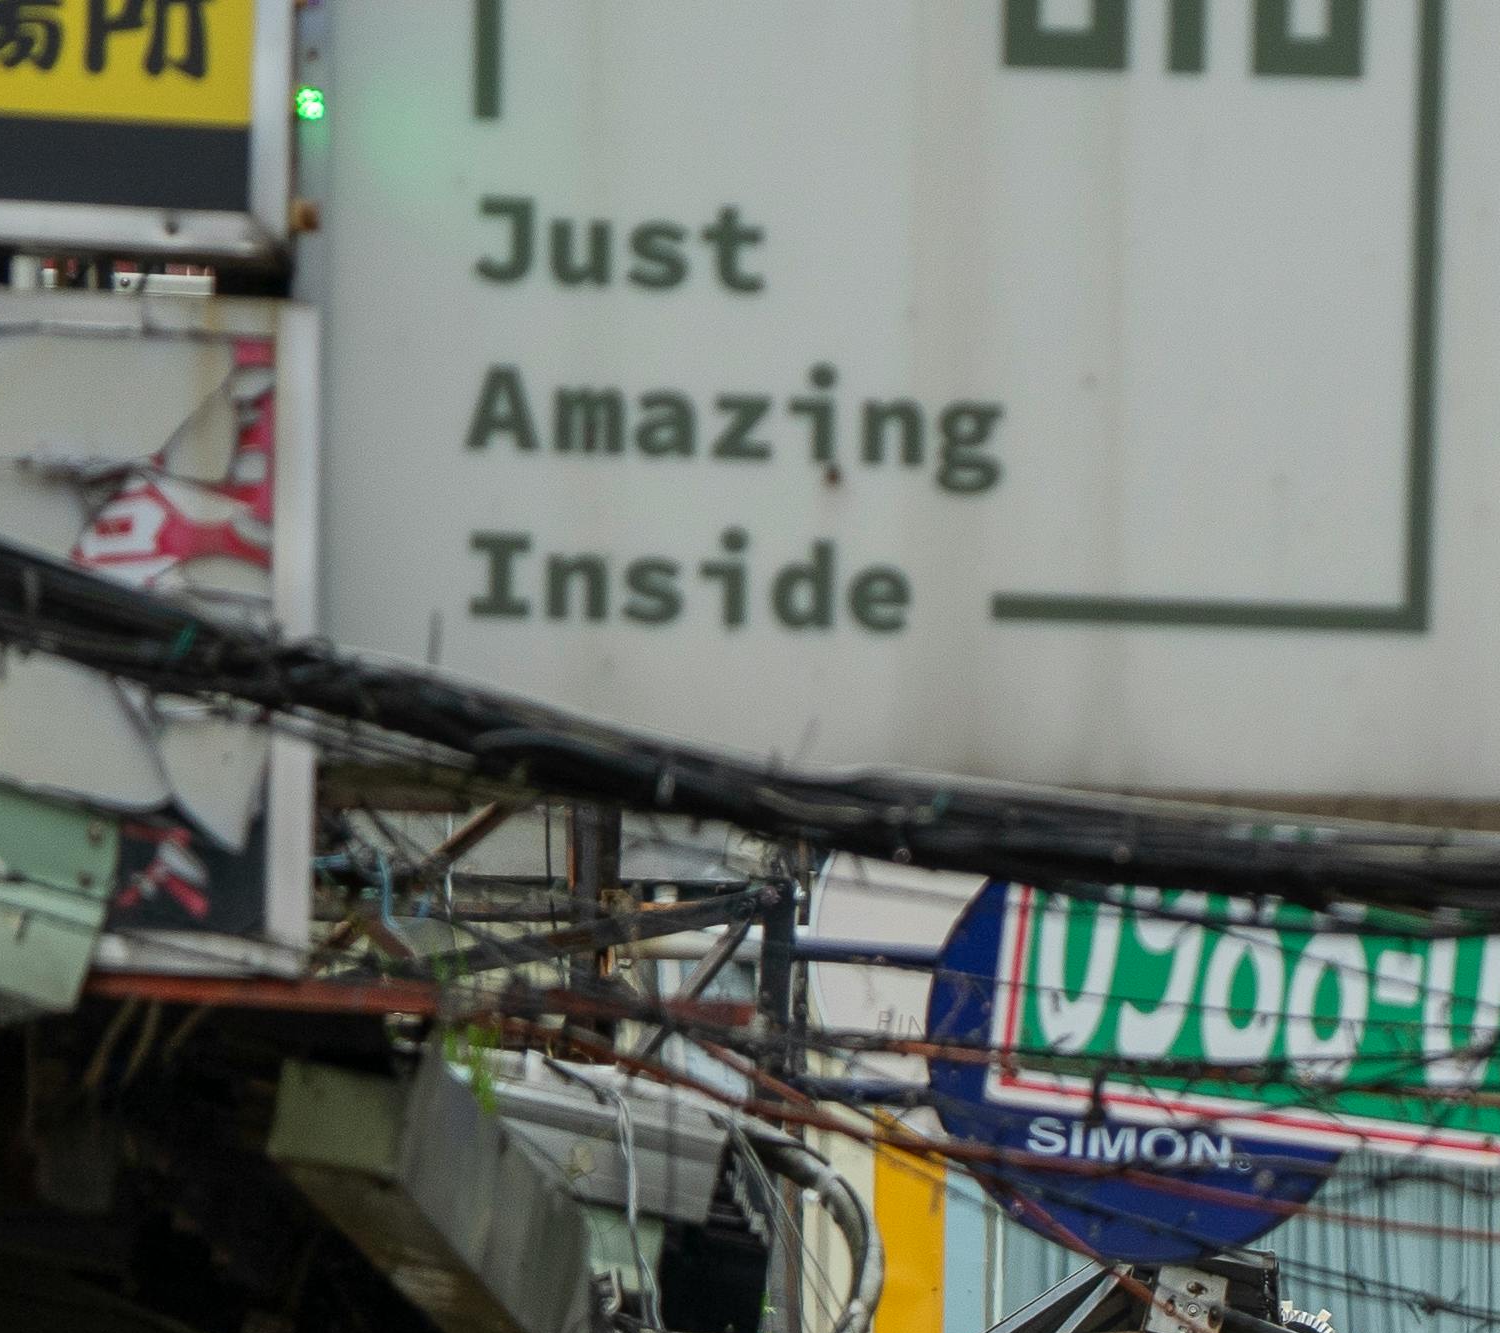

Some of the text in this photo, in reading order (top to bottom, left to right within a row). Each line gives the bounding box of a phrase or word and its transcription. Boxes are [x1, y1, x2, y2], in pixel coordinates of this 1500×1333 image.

[474, 195, 767, 294] Just
[466, 362, 1004, 495] Amazing
[469, 530, 912, 632] Inside
[1026, 1116, 1235, 1169] SIMON
